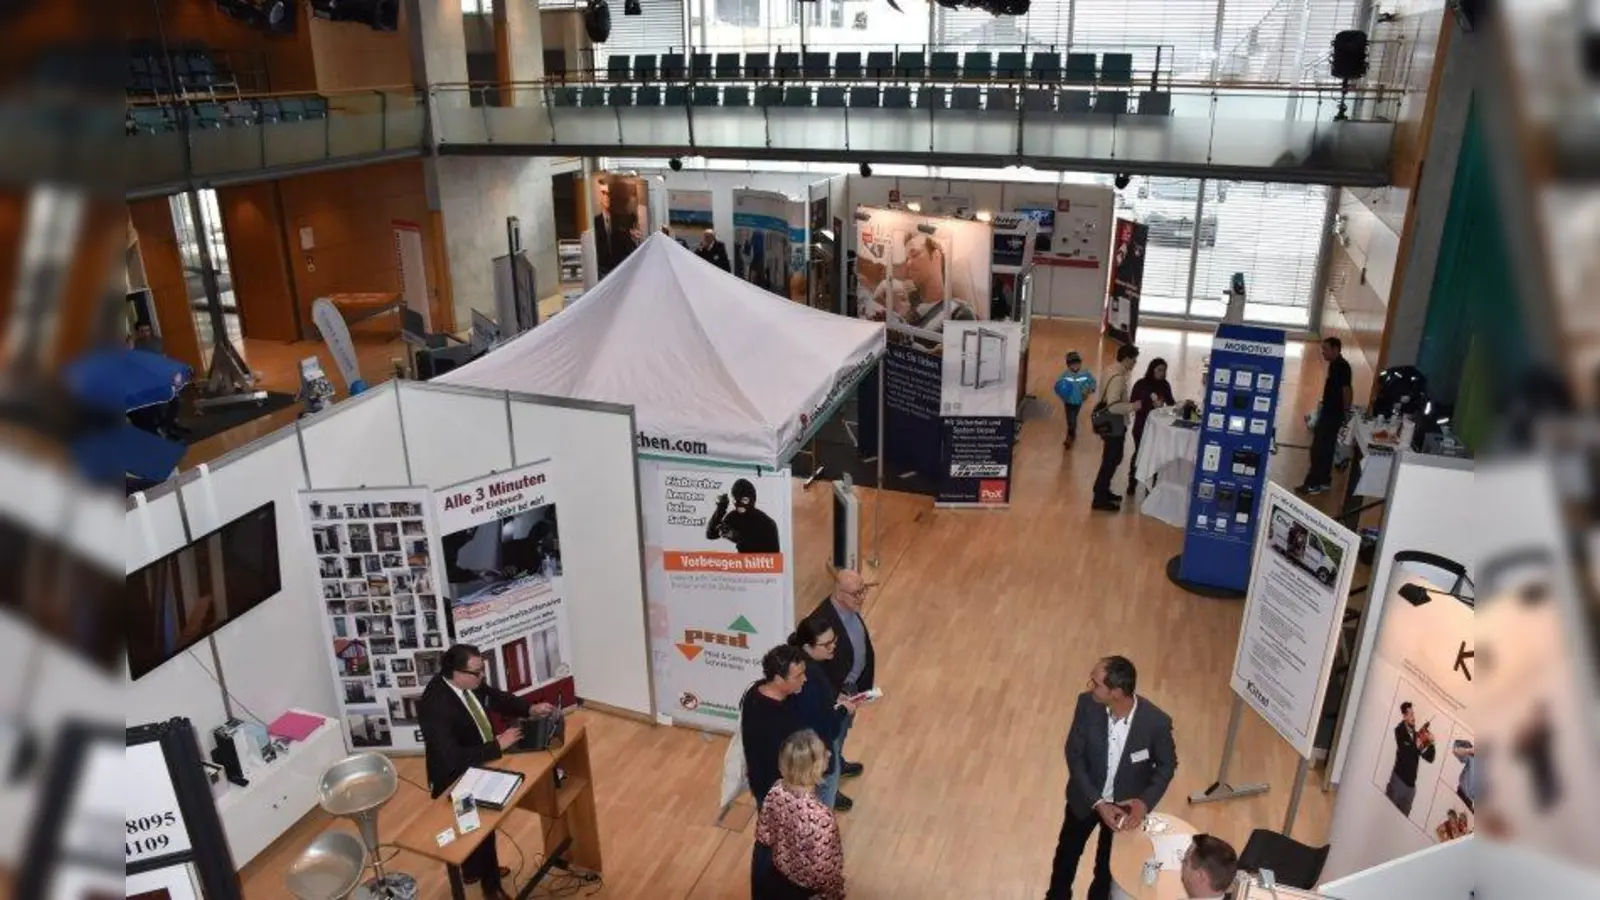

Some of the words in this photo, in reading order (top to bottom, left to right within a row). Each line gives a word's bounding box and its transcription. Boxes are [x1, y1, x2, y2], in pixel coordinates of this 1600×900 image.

[444, 493, 472, 511] Alle
[476, 487, 486, 501] 3
[489, 473, 546, 498] Minuten
[471, 504, 484, 515] ein
[486, 493, 525, 510] Einbruch
[680, 556, 743, 570] Vorbeugen
[744, 557, 775, 570] hilft!
[126, 811, 176, 835] 8095
